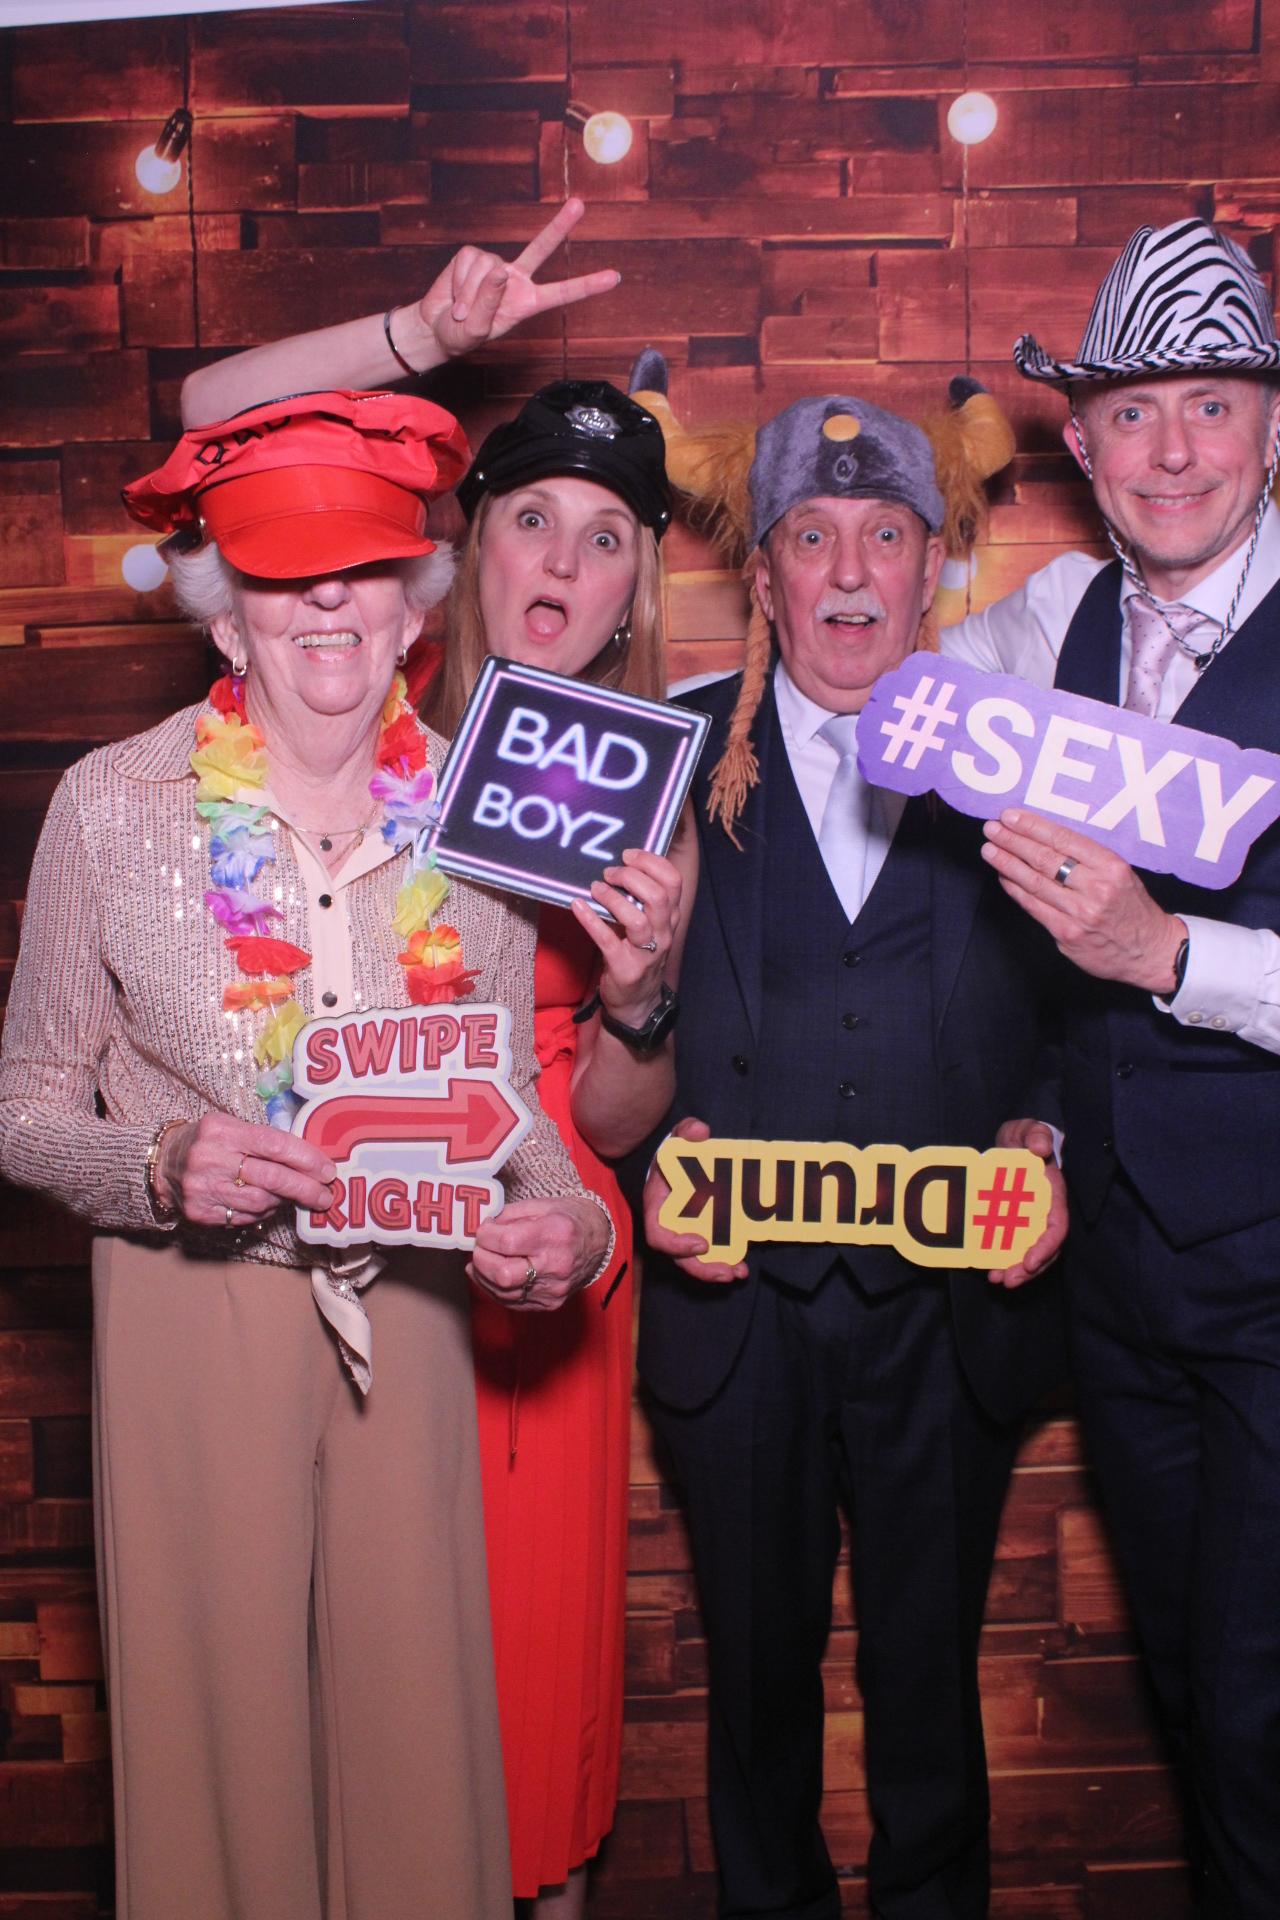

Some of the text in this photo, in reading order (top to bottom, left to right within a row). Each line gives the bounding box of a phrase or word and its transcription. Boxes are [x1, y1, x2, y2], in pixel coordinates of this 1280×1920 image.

[497, 707, 648, 790] BAD
[880, 675, 1276, 864] #SEXY
[473, 782, 625, 861] BOYZ
[306, 1013, 499, 1086] SWIPE
[310, 1176, 491, 1238] RIGHT
[676, 1155, 1036, 1251] #Drunk
